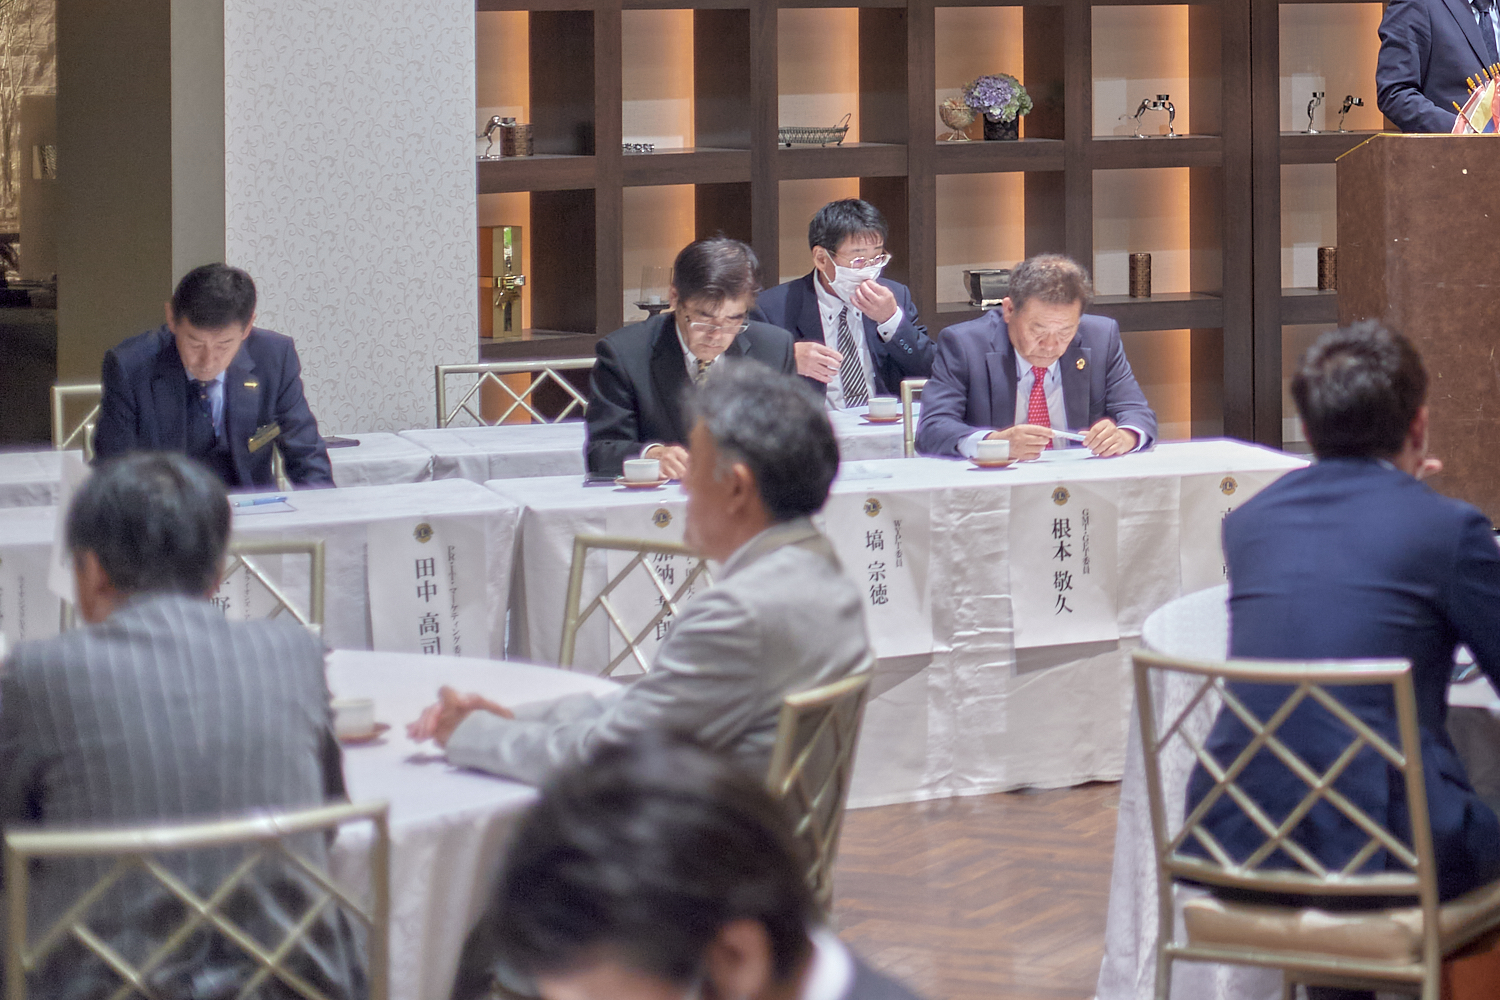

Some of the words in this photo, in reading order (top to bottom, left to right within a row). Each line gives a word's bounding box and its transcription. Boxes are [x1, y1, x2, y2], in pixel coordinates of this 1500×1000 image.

[1051, 517, 1072, 562] 根本
[415, 557, 437, 604] 田中
[867, 560, 889, 605] 宗徳
[1053, 570, 1074, 616] 敬久
[418, 611, 441, 655] 高司
